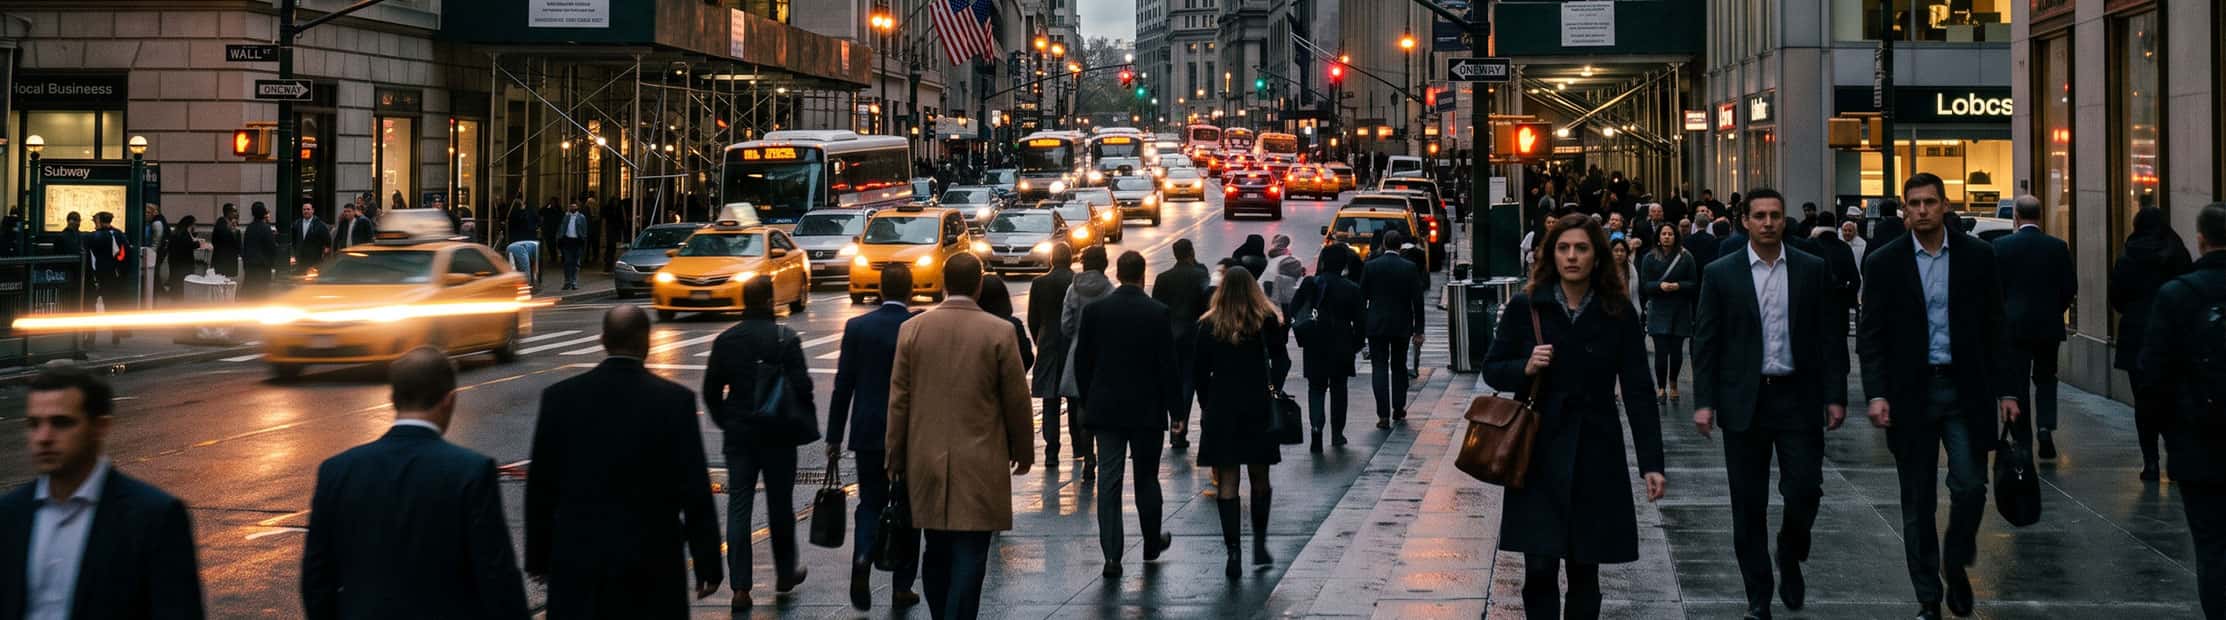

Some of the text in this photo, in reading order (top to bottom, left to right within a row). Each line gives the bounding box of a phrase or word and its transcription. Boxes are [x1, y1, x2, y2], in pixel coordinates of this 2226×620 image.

[230, 48, 262, 60] WALL
[1936, 92, 2013, 115] Lobcs
[44, 166, 90, 179] Subway
